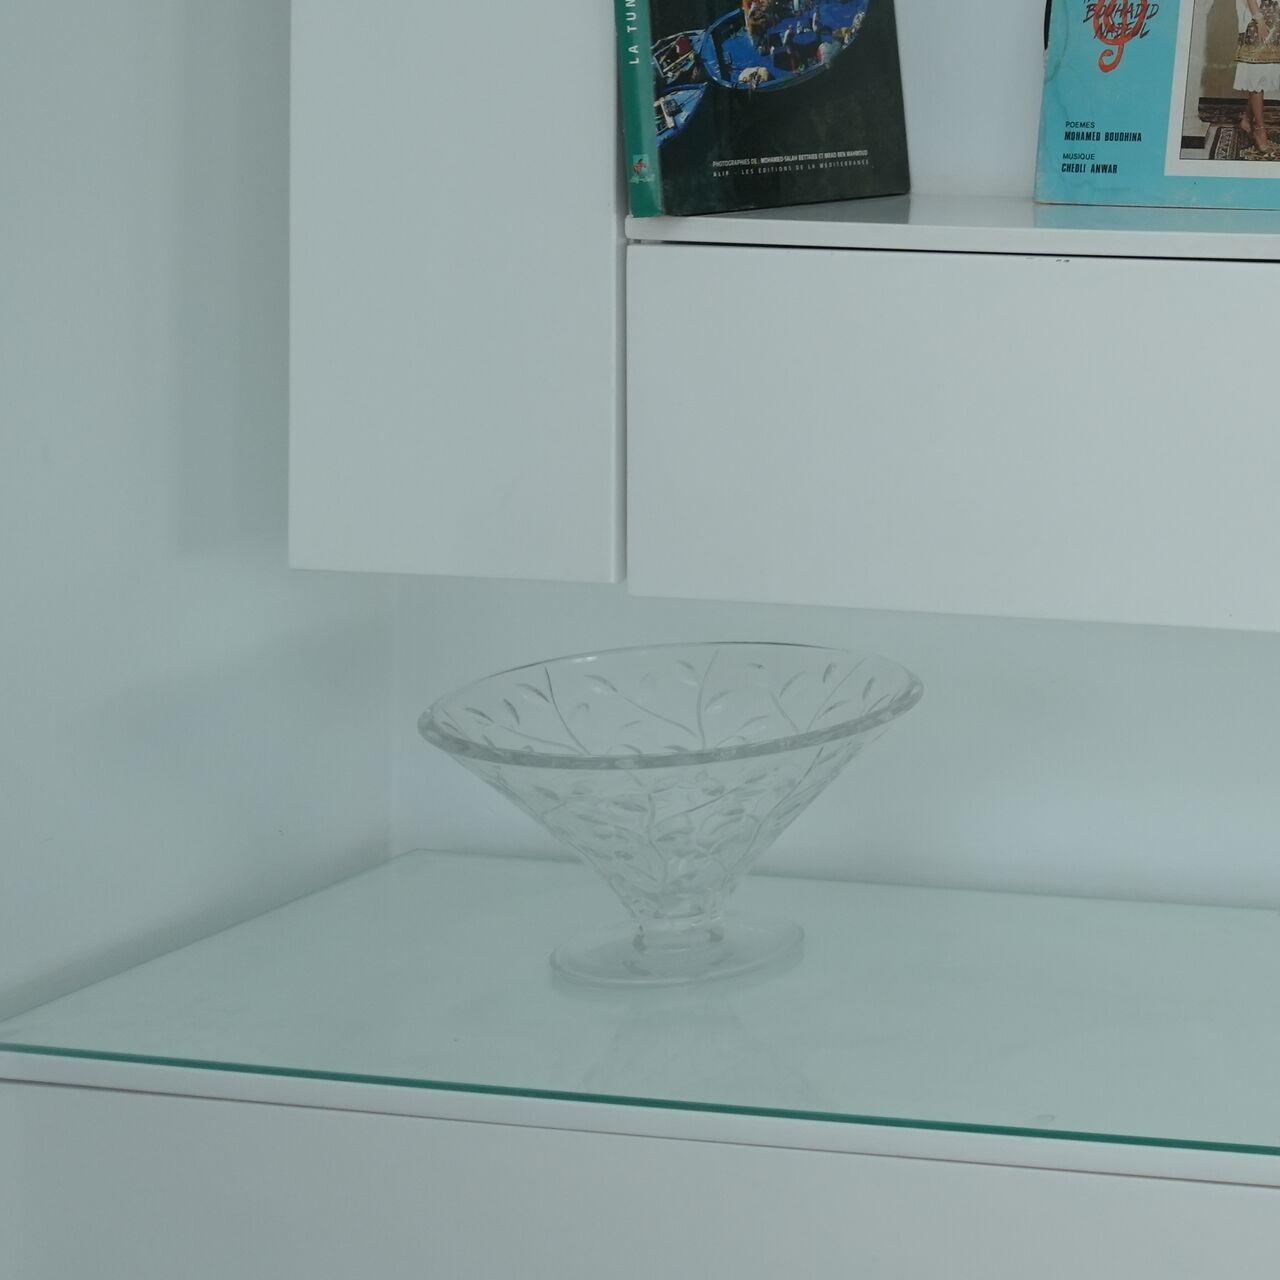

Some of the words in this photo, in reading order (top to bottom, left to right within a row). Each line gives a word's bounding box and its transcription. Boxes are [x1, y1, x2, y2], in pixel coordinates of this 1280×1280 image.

[629, 45, 639, 65] LA
[1064, 131, 1101, 141] MOHAMED
[1062, 163, 1086, 173] CHEBLI
[1090, 164, 1118, 174] ANWAR
